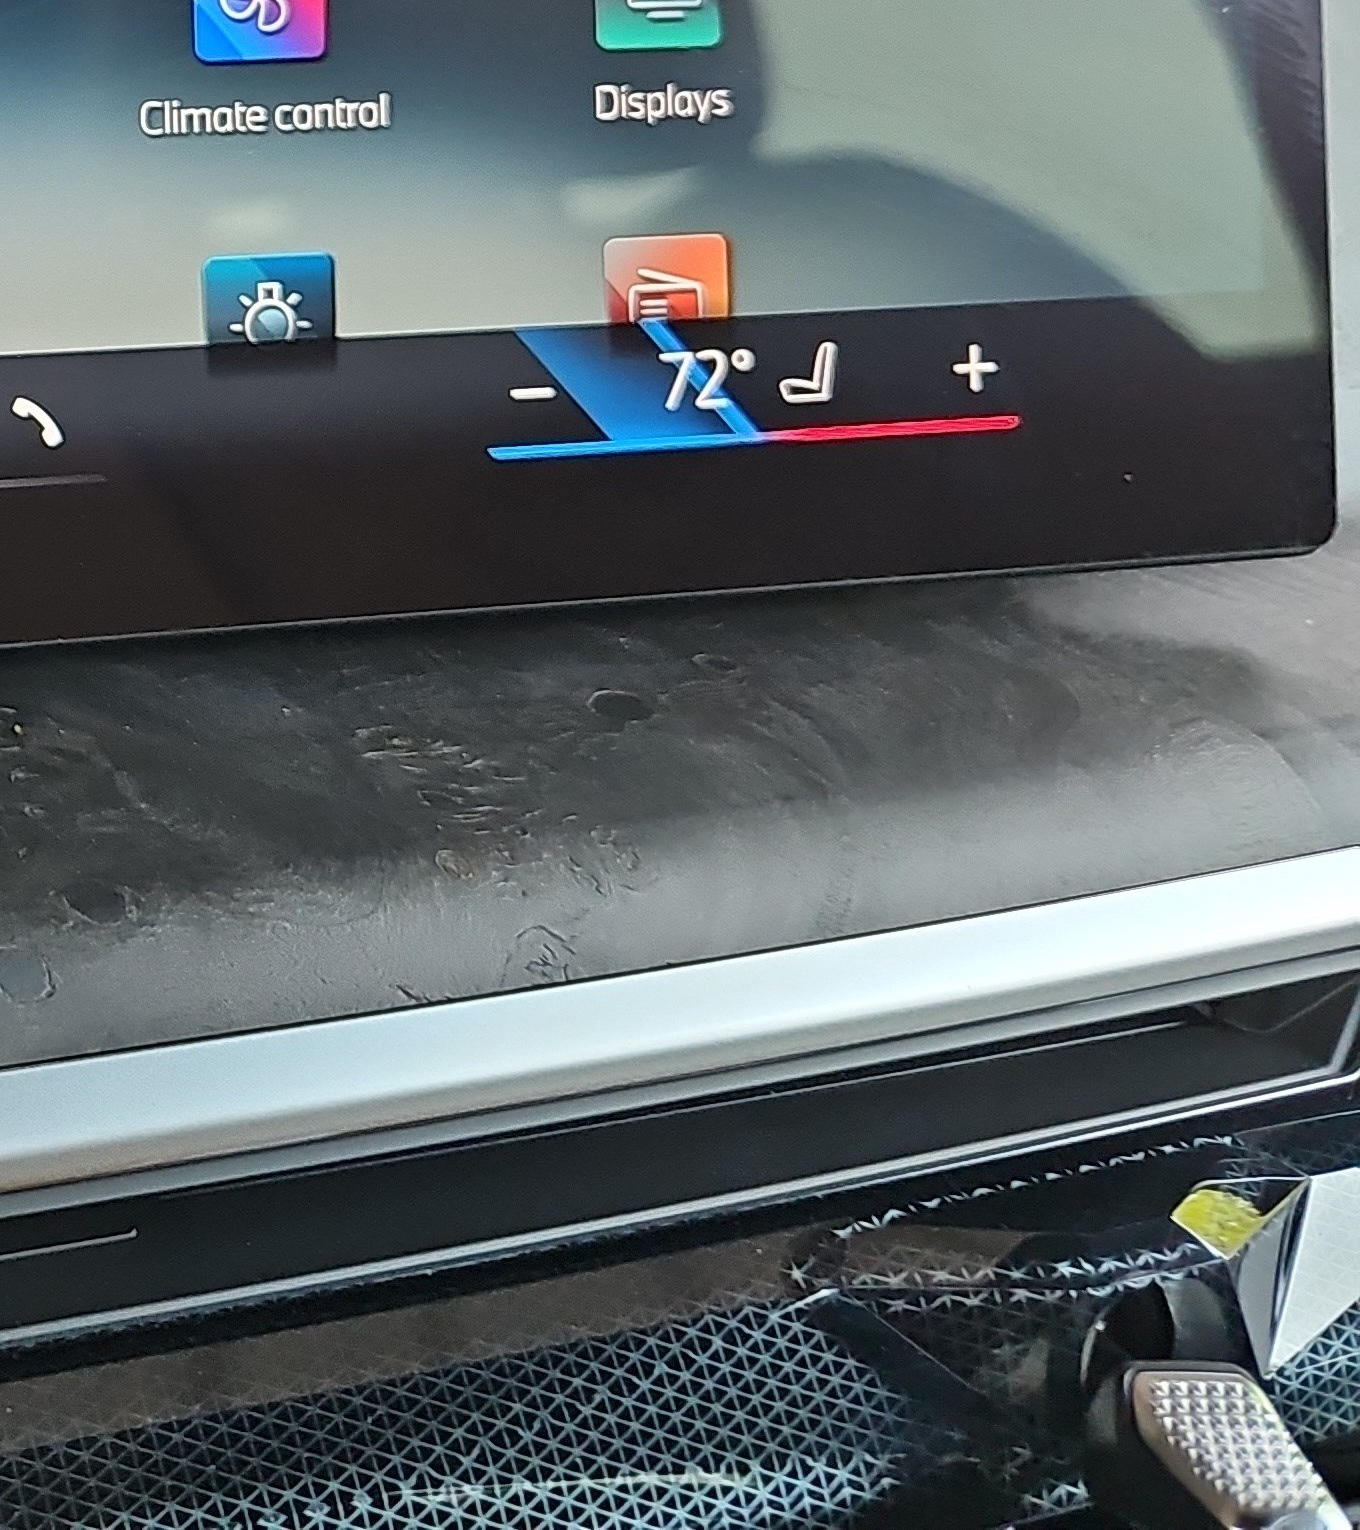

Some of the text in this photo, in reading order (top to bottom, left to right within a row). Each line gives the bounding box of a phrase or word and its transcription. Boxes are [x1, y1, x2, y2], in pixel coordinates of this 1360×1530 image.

[139, 94, 391, 137] Climate control
[593, 85, 735, 127] Displays
